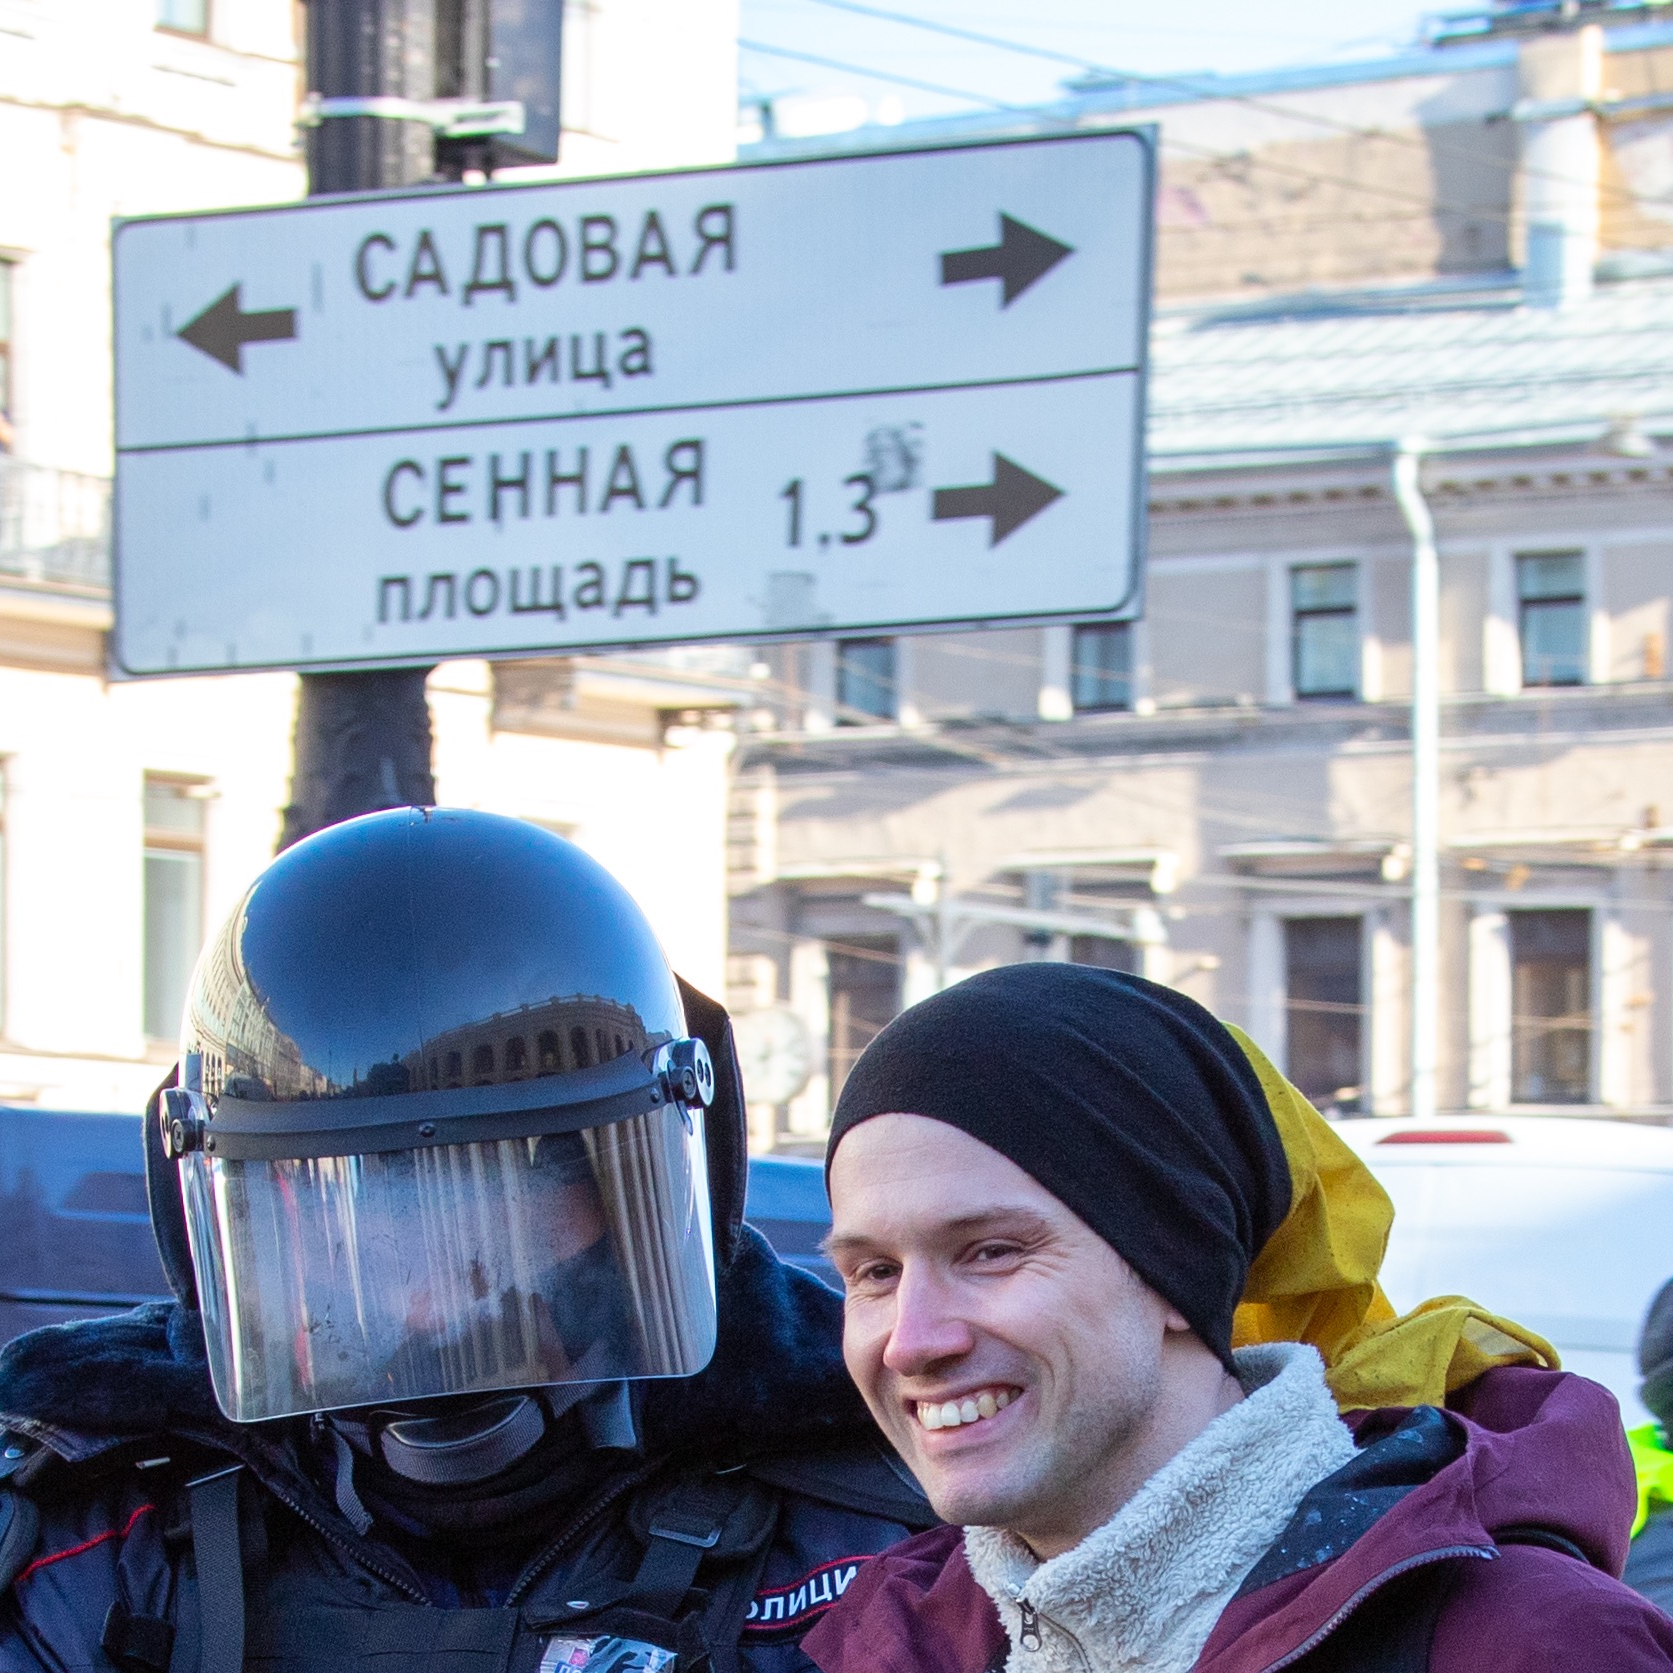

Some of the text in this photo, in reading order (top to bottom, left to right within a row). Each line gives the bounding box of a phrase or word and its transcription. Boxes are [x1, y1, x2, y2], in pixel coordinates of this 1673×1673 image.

[353, 202, 738, 306] САДОВАЯ
[433, 324, 654, 413] улица
[383, 437, 880, 548] СЕННАЯ 1.3
[377, 556, 701, 624] площадь
